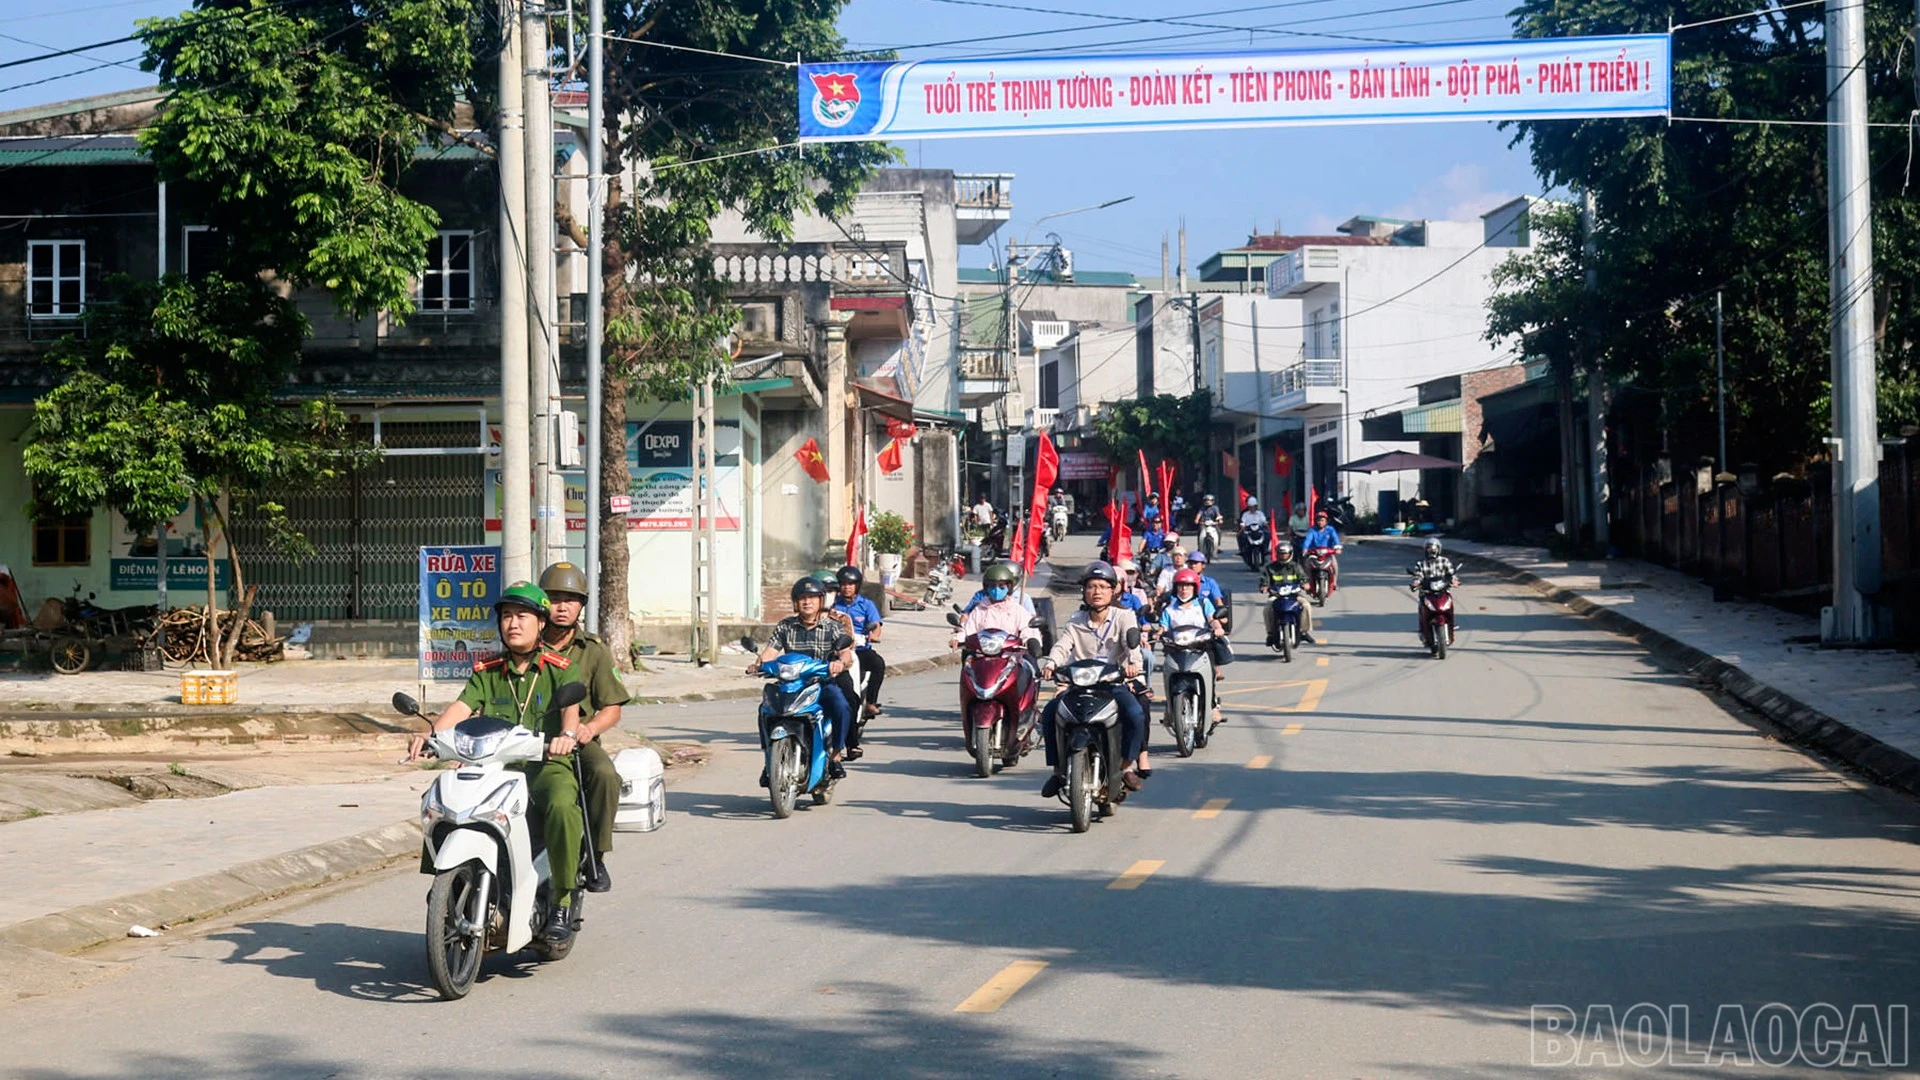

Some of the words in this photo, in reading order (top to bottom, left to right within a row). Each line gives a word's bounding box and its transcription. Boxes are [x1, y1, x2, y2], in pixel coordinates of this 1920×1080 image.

[924, 71, 961, 115] TUỔI
[966, 72, 997, 113] TRẺ
[1002, 78, 1053, 118] TRỊNH
[1058, 70, 1114, 110] TƯỜNG
[1130, 68, 1177, 107] ĐOÀN
[1182, 64, 1213, 104] KẾT
[1230, 66, 1268, 102] TIÊN
[1274, 69, 1332, 101] PHONG
[1349, 58, 1386, 99] BẢN
[1391, 60, 1431, 98] LĨNH
[1447, 58, 1481, 103] ĐỘT
[1486, 57, 1521, 95] PHÁ
[1538, 57, 1583, 93] PHÁT
[1588, 47, 1639, 92] TRIỂN
[119, 562, 145, 576] ĐIỆN
[172, 562, 187, 575] LÊ
[427, 549, 466, 573] RỬA
[471, 554, 496, 573] XE
[436, 578, 452, 598] Ô
[459, 578, 487, 598] TÔ
[431, 606, 451, 620] XE
[457, 604, 491, 620] MÁY
